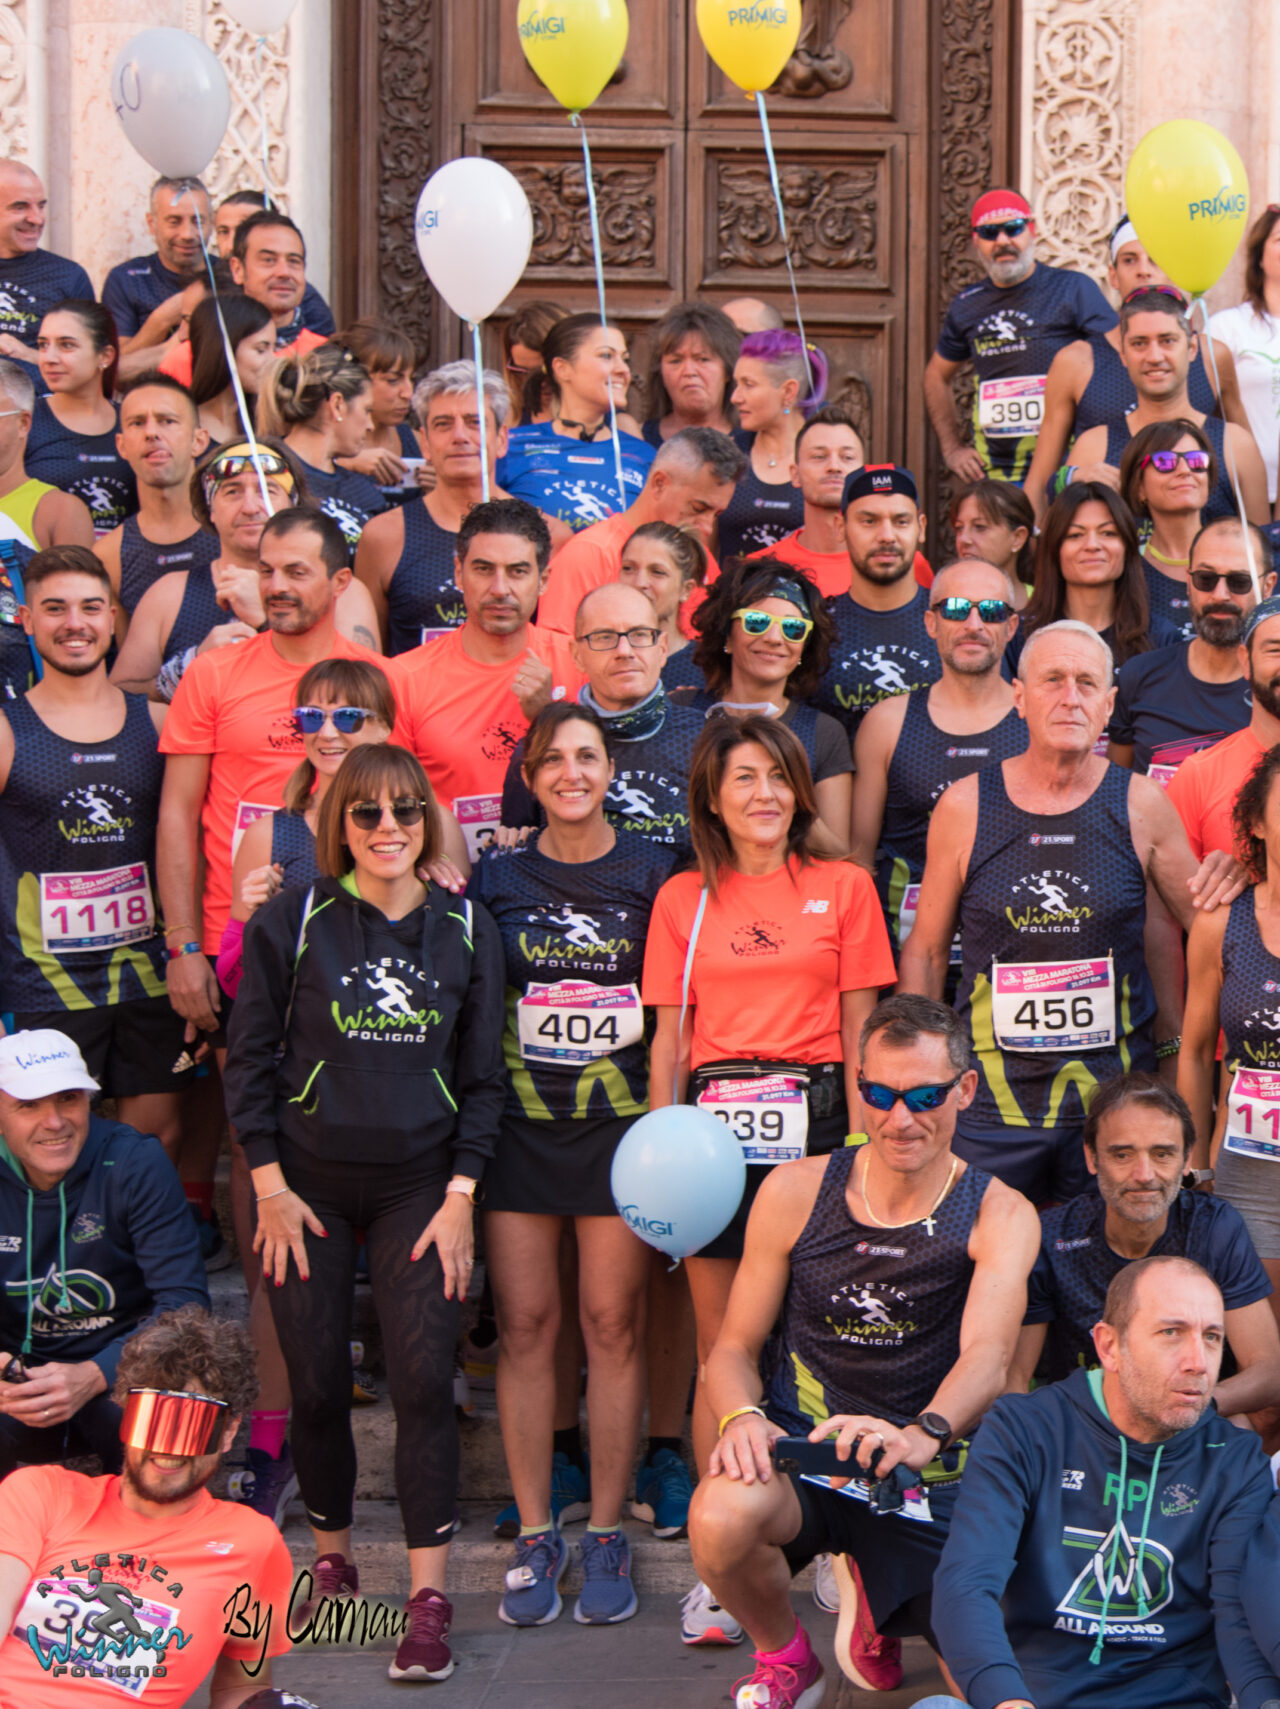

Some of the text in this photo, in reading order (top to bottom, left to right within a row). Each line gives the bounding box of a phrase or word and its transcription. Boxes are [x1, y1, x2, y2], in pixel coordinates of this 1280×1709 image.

[728, 5, 788, 27] PRIMIGI
[1188, 187, 1245, 221] PRIMIG
[991, 401, 1041, 424] 390
[872, 475, 893, 487] IAM
[842, 645, 929, 669] ATLETICA
[60, 783, 132, 808] ATLETICA
[58, 816, 136, 843] Winner
[604, 812, 690, 834] inner
[71, 834, 126, 844] FOLIGNO
[1011, 870, 1090, 893] ATLETICA
[50, 895, 147, 935] 1118
[1005, 906, 1095, 929] Winner
[519, 932, 634, 963] Winner
[536, 959, 618, 971] FOLIGNO
[331, 1000, 444, 1034] Winner
[1014, 996, 1094, 1030] 456
[348, 1030, 426, 1043] FOLIGNO
[538, 1014, 620, 1045] 404
[16, 1050, 71, 1071] Winner
[830, 1282, 916, 1309] ATLETICA
[826, 1315, 920, 1337] Winner
[840, 1333, 903, 1346] FOLIGNO
[1103, 1474, 1147, 1511] RP
[1053, 1616, 1165, 1635] ALL AROUND
